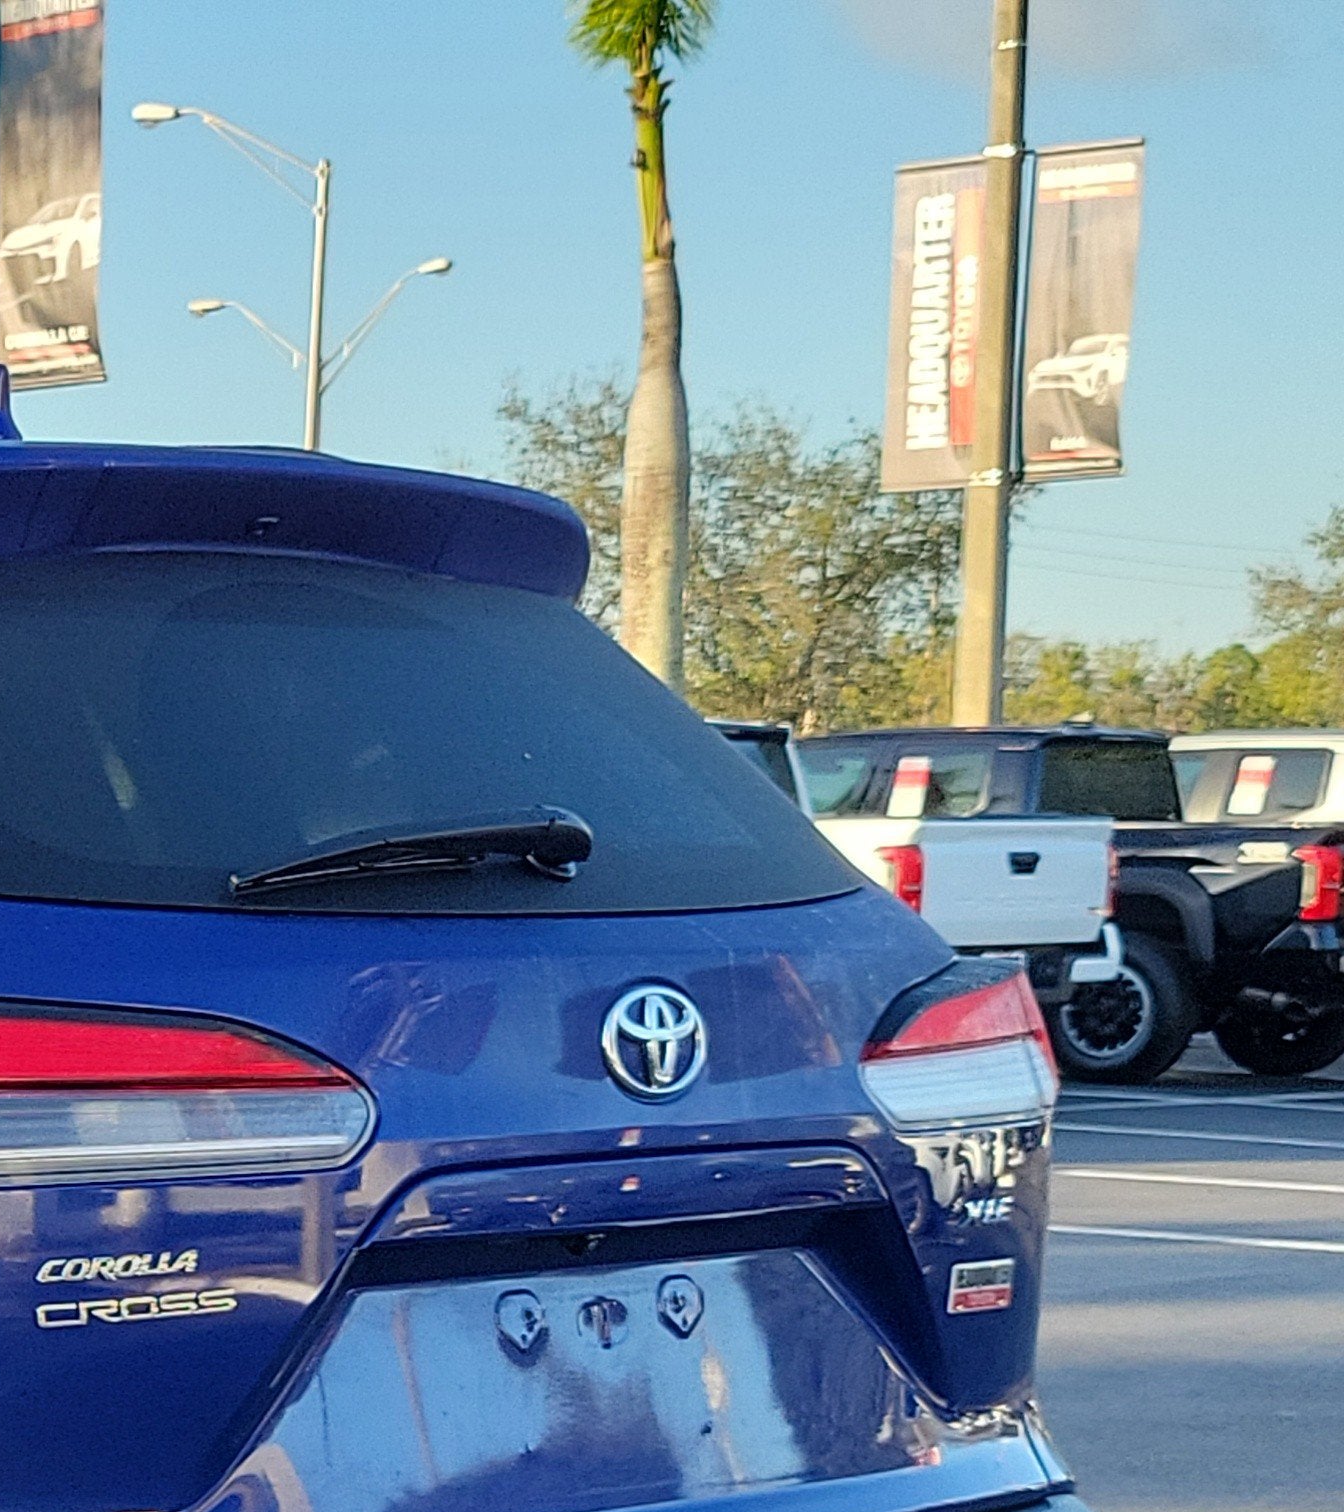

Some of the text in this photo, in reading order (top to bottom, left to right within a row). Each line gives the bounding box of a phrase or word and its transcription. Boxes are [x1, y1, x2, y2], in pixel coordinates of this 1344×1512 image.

[905, 192, 956, 451] HEADQUARTER
[35, 1248, 199, 1284] COROLLA
[35, 1288, 238, 1328] CROSS
